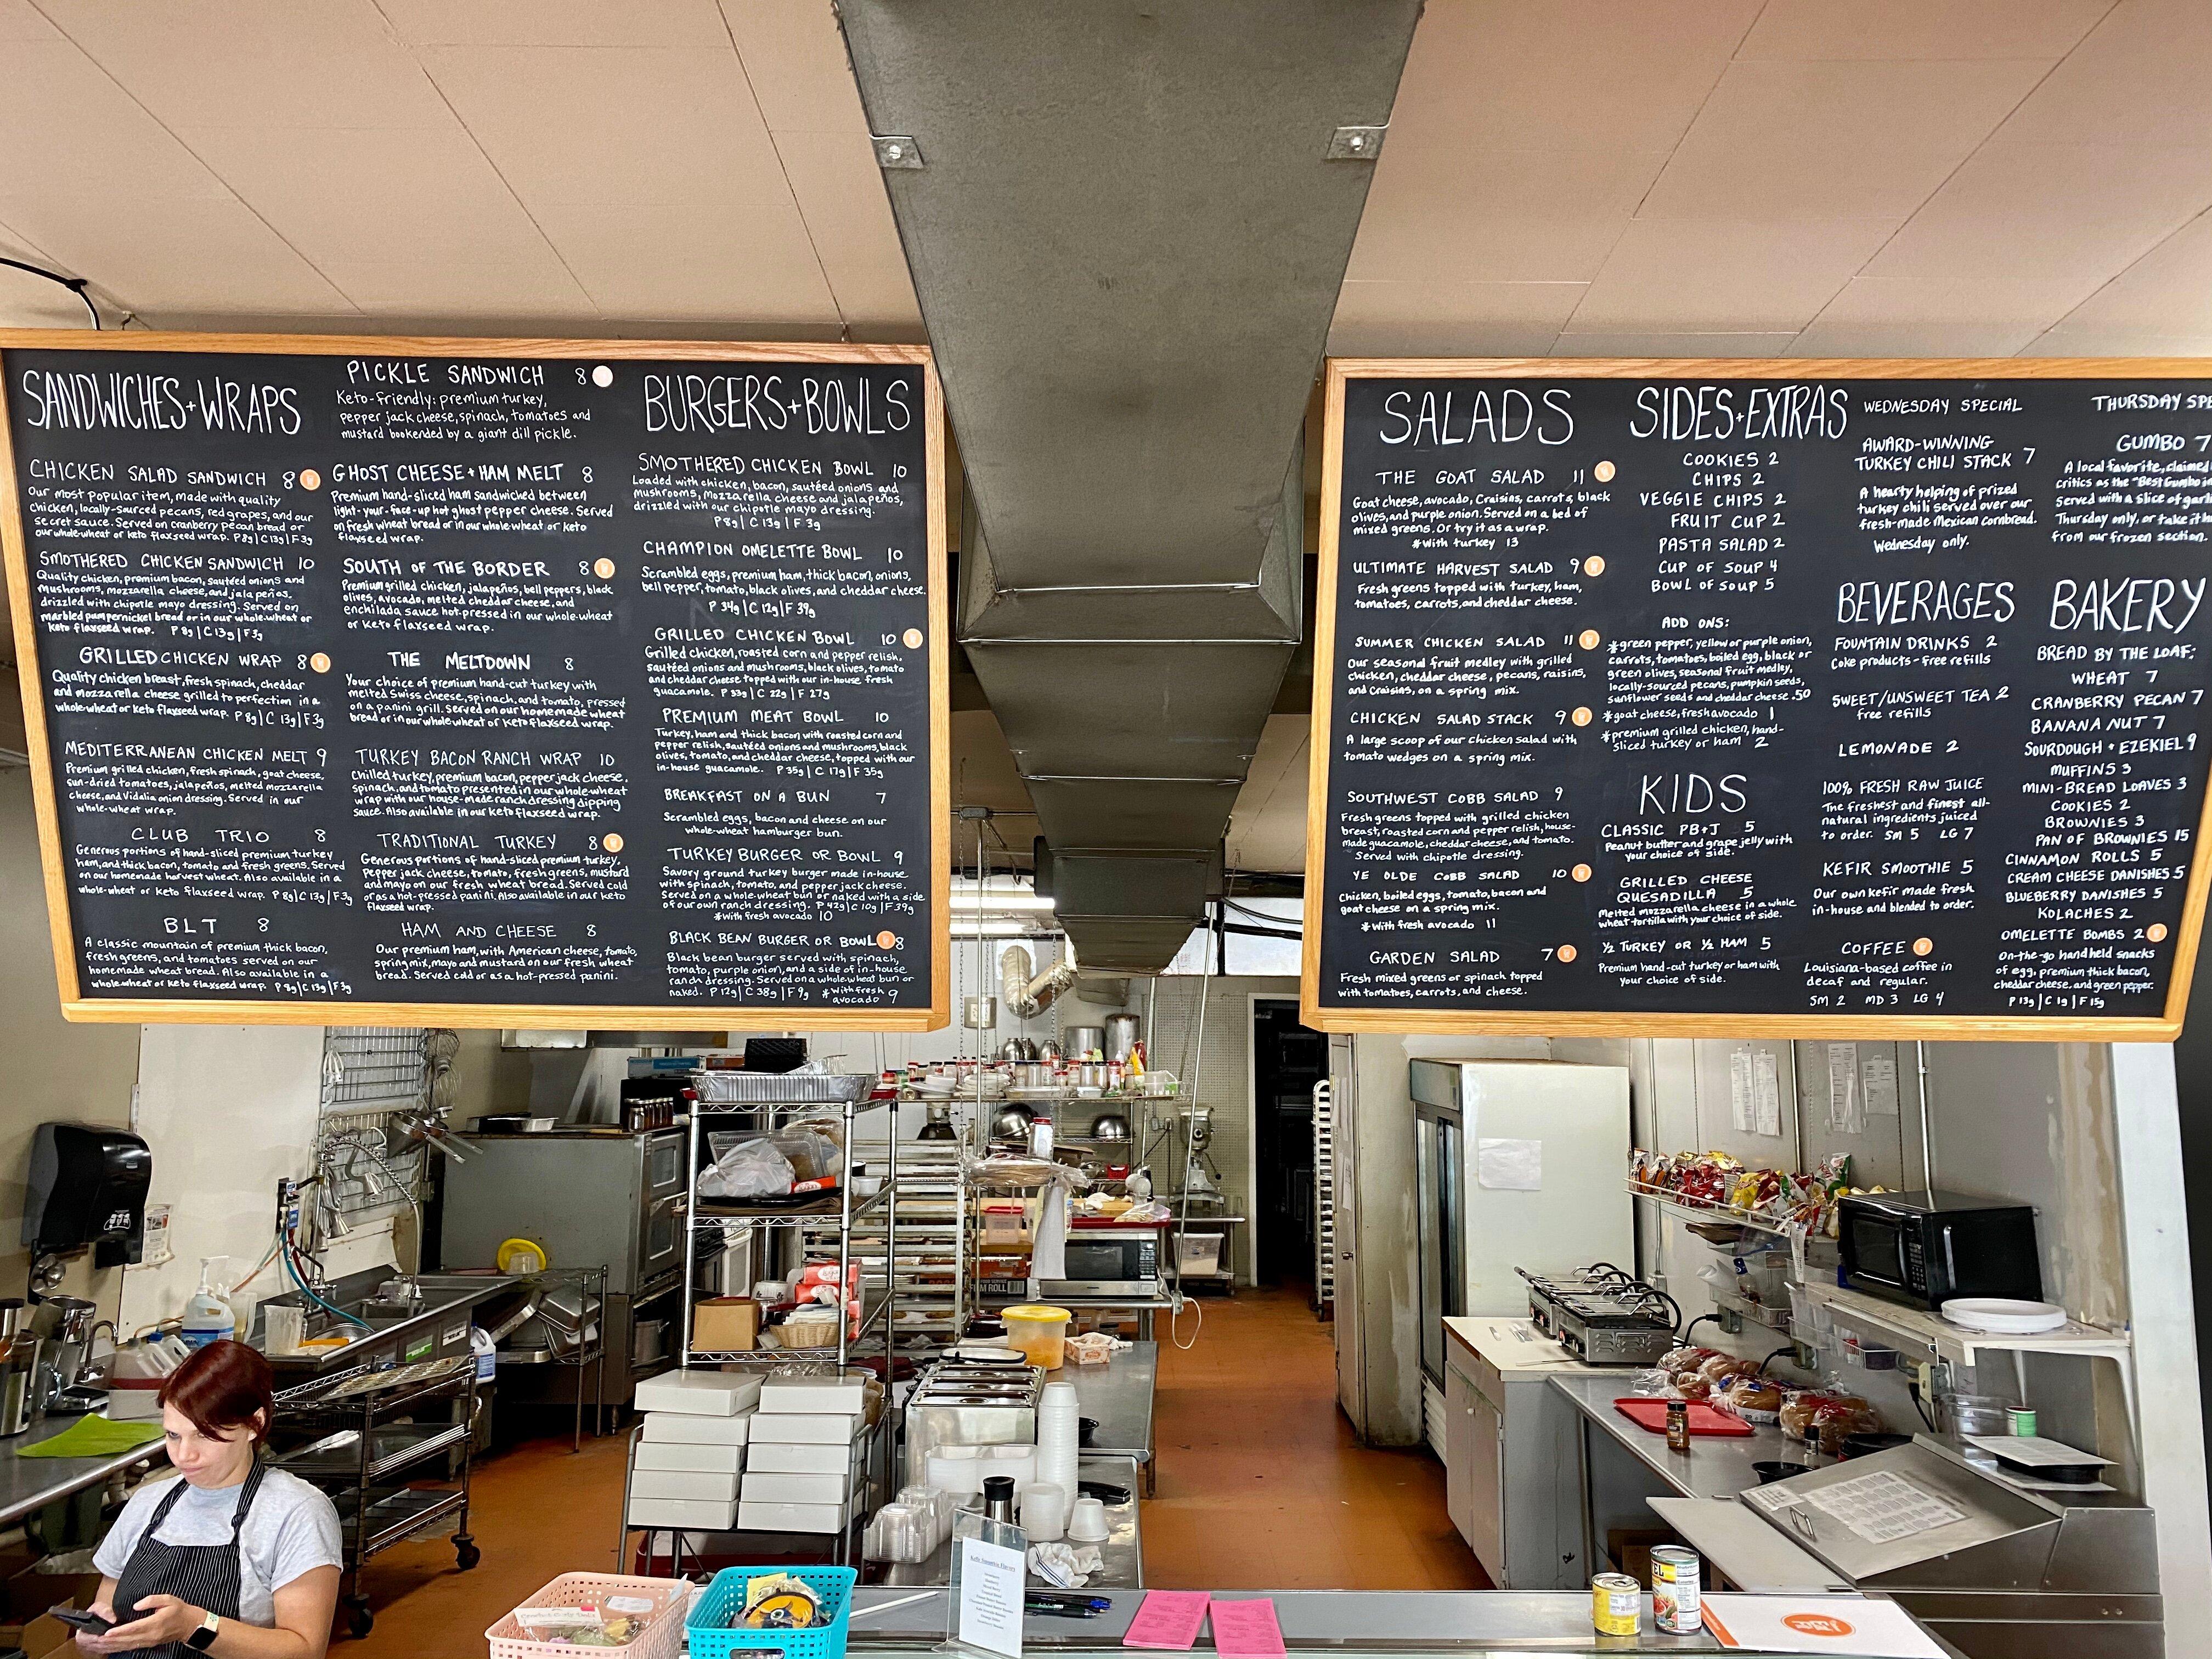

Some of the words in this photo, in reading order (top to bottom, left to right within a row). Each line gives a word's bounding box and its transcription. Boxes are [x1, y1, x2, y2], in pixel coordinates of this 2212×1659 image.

[347, 360, 430, 385] PICKLE
[448, 365, 544, 386] SANDWICH
[575, 368, 586, 385] 8
[336, 389, 436, 410] Keto-friendly:
[439, 391, 499, 410] premium
[501, 392, 547, 409] turkey,
[1864, 398, 1950, 415] WEDNESDAY
[1961, 397, 2023, 412] SPECIAL
[1380, 389, 1573, 446] SALADS
[341, 426, 384, 439] mustard
[388, 426, 443, 439] bookended
[445, 428, 460, 442] by
[464, 431, 474, 439] a
[478, 427, 507, 443] giant
[512, 426, 530, 439] dill
[534, 426, 577, 443] pickle.
[2116, 433, 2185, 452] GUMBO
[2194, 434, 2212, 452] 7
[638, 453, 745, 475] SMOTHERED
[751, 458, 822, 475] CHICKEN
[832, 461, 874, 476] BOWL
[893, 463, 907, 478] 10
[1683, 452, 1759, 467] COOKIES
[1769, 452, 1779, 465] 2
[30, 459, 114, 481] CHICKEN
[127, 465, 178, 483] SALAD
[187, 470, 266, 486] SANDWICH
[282, 471, 296, 489] 8
[332, 464, 389, 483] GHOST
[397, 464, 465, 482] CHEESE
[478, 464, 510, 482] HAM
[517, 463, 564, 481] MELT
[582, 466, 593, 483] 8
[1375, 470, 1416, 485] THE
[1435, 469, 1476, 485] GOAT
[1490, 469, 1545, 484] SALAD
[1573, 469, 1584, 485] 11
[30, 501, 78, 516] chicken,
[80, 503, 157, 517] locally-sourced
[159, 507, 204, 520] pecans,
[1671, 512, 1723, 528] FRUIT
[1731, 514, 1767, 529] CUP
[1772, 512, 1786, 527] 2
[643, 540, 733, 556] CHAMPION
[741, 543, 815, 559] OMELETTE
[821, 544, 863, 561] BOWL
[888, 547, 903, 563] 10
[1873, 535, 1936, 554] Wednesday
[1942, 533, 1970, 550] only.
[343, 557, 402, 575] SOUTH
[411, 561, 426, 574] OF
[432, 560, 466, 574] THE
[471, 561, 550, 577] BORDER
[578, 560, 589, 575] 8
[1837, 580, 2015, 625] BEVERAGES
[2050, 577, 2207, 634] BAKERY
[1835, 636, 1901, 651] FOUNTAIN
[1906, 635, 1970, 651] DRINKS
[1985, 635, 1998, 648] 2
[387, 651, 421, 667] THE
[445, 651, 531, 670] MELTDOWN
[564, 657, 574, 671] 8
[1347, 658, 1369, 669] Our
[1373, 657, 1426, 669] seasonal
[1429, 656, 1460, 670] fruit
[1464, 656, 1507, 670] medley
[1510, 655, 1533, 667] with
[1536, 652, 1572, 670] grilled
[2031, 694, 2124, 710] CRANBERRY
[2134, 691, 2186, 707] PECAN
[2190, 689, 2204, 705] 7
[65, 740, 195, 759] MEDITERRANEAN
[203, 747, 263, 762] CHICKEN
[272, 750, 308, 765] MELT
[316, 748, 327, 767] 9
[354, 748, 419, 766] TURKEY
[430, 749, 476, 766] BACON
[481, 750, 531, 766] RANCH
[539, 752, 582, 766] WRAP
[600, 753, 615, 766] 10
[1838, 741, 1933, 757] LEMONADE
[1945, 740, 1959, 753] 2
[1343, 750, 1384, 761] tomato
[1386, 751, 1429, 765] wedges
[1432, 753, 1448, 762] on
[1468, 752, 1505, 767] spring
[1510, 752, 1536, 762] mix.
[2050, 762, 2116, 778] MUFFINS
[2121, 763, 2132, 775] 3
[664, 788, 743, 803] BREAKFAST
[753, 789, 771, 802] ON
[778, 792, 786, 803] A
[795, 789, 830, 803] BUN
[875, 792, 887, 804] 7
[1347, 791, 1438, 805] SOUTHWEST
[1448, 792, 1486, 804] COBB
[1493, 791, 1538, 803] SALAD
[1555, 786, 1564, 801] 9
[1639, 774, 1747, 815] KIDS
[1821, 814, 1867, 826] natural
[1873, 812, 1937, 828] ingredients
[1938, 810, 1978, 825] juiced
[131, 827, 189, 843] CLUB
[215, 830, 269, 843] TRIO
[314, 828, 326, 842] 8
[685, 825, 749, 836] whole-wheat
[752, 826, 812, 840] hamburger
[816, 827, 843, 838] bun.
[1601, 823, 1664, 838] CLASSIC
[1679, 823, 1720, 836] PB+J
[1744, 821, 1756, 832] 5
[2005, 853, 2080, 867] CINNAMON
[2091, 849, 2140, 863] ROLLS
[2149, 848, 2163, 861] 5
[1822, 861, 1872, 877] KEFIR
[1881, 861, 1951, 874] SMOOTHIE
[1960, 859, 1974, 874] 5
[2038, 906, 2114, 921] KOLACHES
[2119, 908, 2134, 919] 2
[84, 936, 92, 947] A
[97, 938, 138, 949] classic
[141, 941, 198, 950] mountain
[200, 940, 213, 951] of
[217, 942, 261, 952] premium
[263, 942, 292, 953] thick
[295, 942, 328, 955] bacon,
[1841, 940, 1906, 956] COFFEE
[1369, 951, 1435, 966] GARDEN
[1449, 950, 1500, 963] SALAD
[1541, 948, 1554, 961] 7
[1620, 977, 1643, 987] your
[1646, 975, 1679, 985] choice
[1684, 974, 1697, 983] of
[1699, 973, 1726, 984] side.
[1836, 995, 1846, 1006] 2
[1865, 995, 1884, 1006] MD
[1890, 994, 1898, 1005] 3
[1913, 993, 1929, 1003] LG
[1936, 991, 1944, 1006] 4
[988, 1284, 1007, 1292] ROLL
[1651, 1561, 1664, 1577] EL
